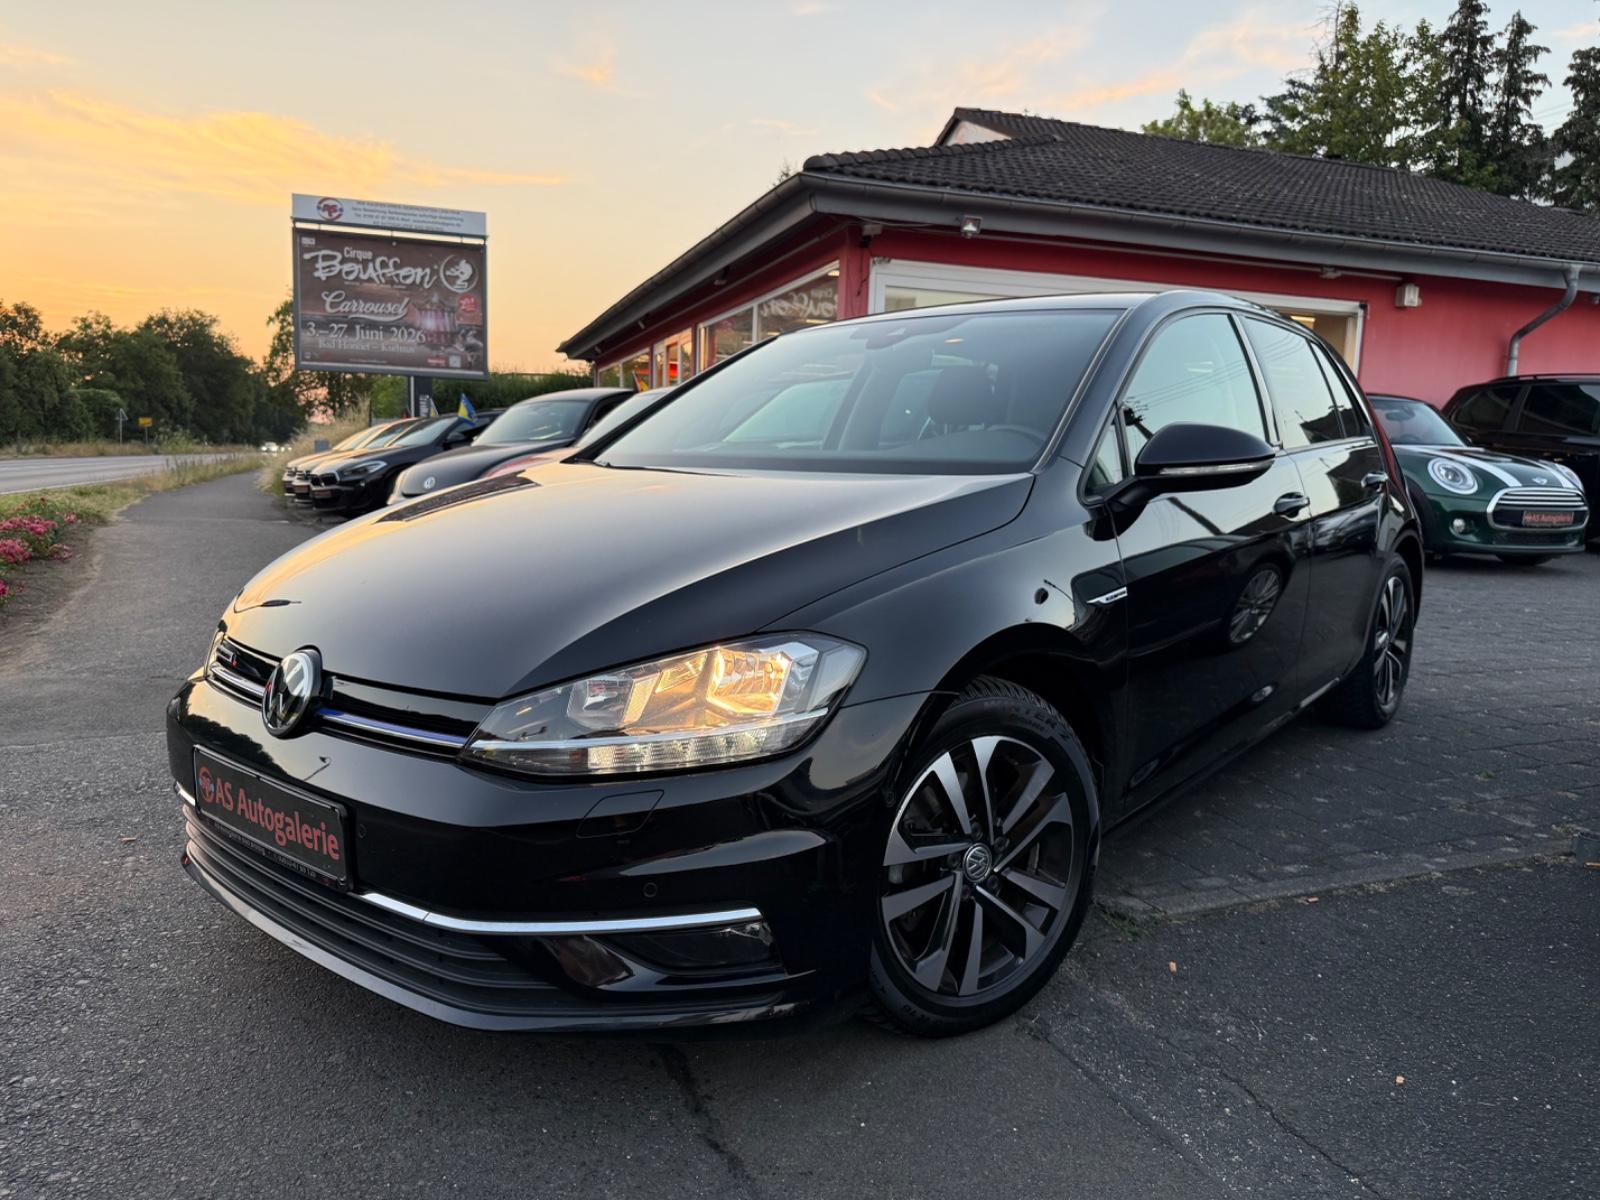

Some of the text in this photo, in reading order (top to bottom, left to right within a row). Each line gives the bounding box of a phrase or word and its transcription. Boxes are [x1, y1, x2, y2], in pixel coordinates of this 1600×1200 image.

[344, 246, 373, 260] Cirque
[303, 249, 437, 289] Bouffon
[321, 290, 410, 319] Carrousel
[355, 324, 383, 340] Juni
[390, 327, 426, 344] 2026
[215, 777, 234, 812] AS
[237, 788, 340, 860] Autogalerie
